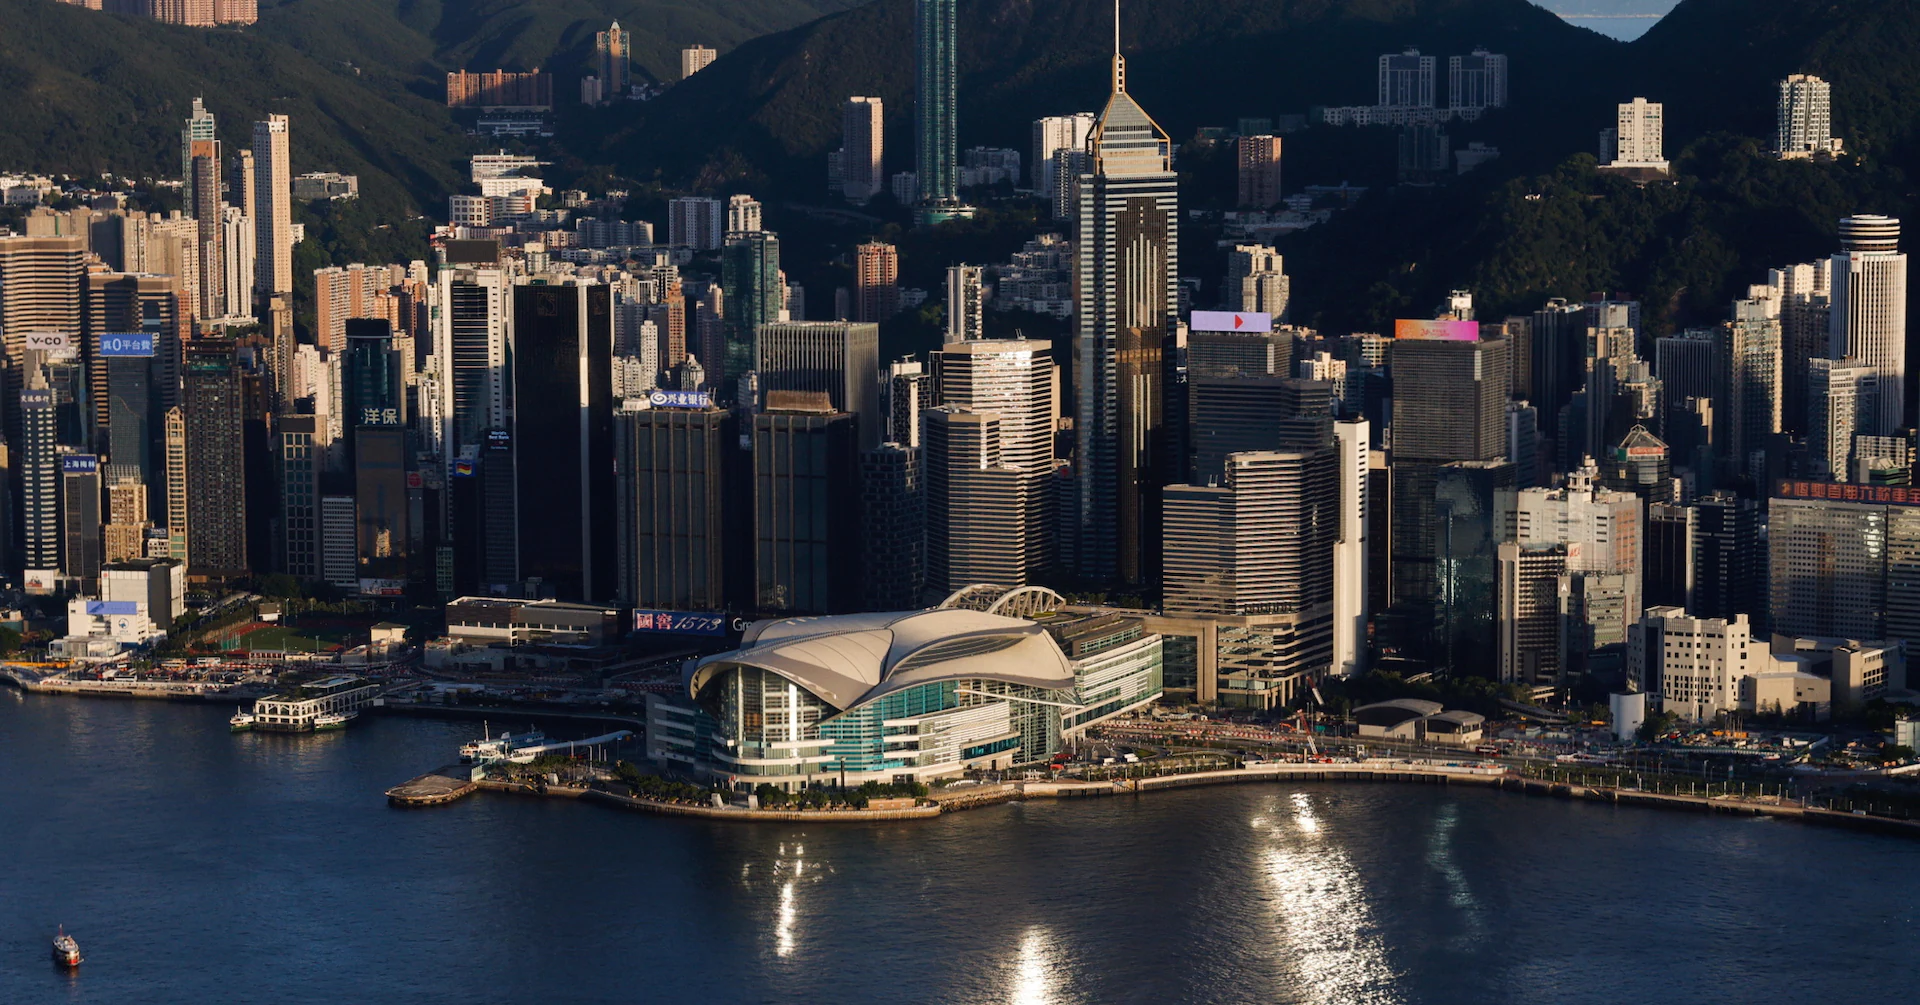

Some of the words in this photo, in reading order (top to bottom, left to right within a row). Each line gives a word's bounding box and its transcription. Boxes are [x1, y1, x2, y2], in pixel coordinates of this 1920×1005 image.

[31, 337, 62, 346] V-CO
[667, 393, 708, 406] 兴业银行
[361, 408, 398, 425] 洋保
[636, 612, 673, 630] 國窖
[674, 616, 722, 631] 1573
